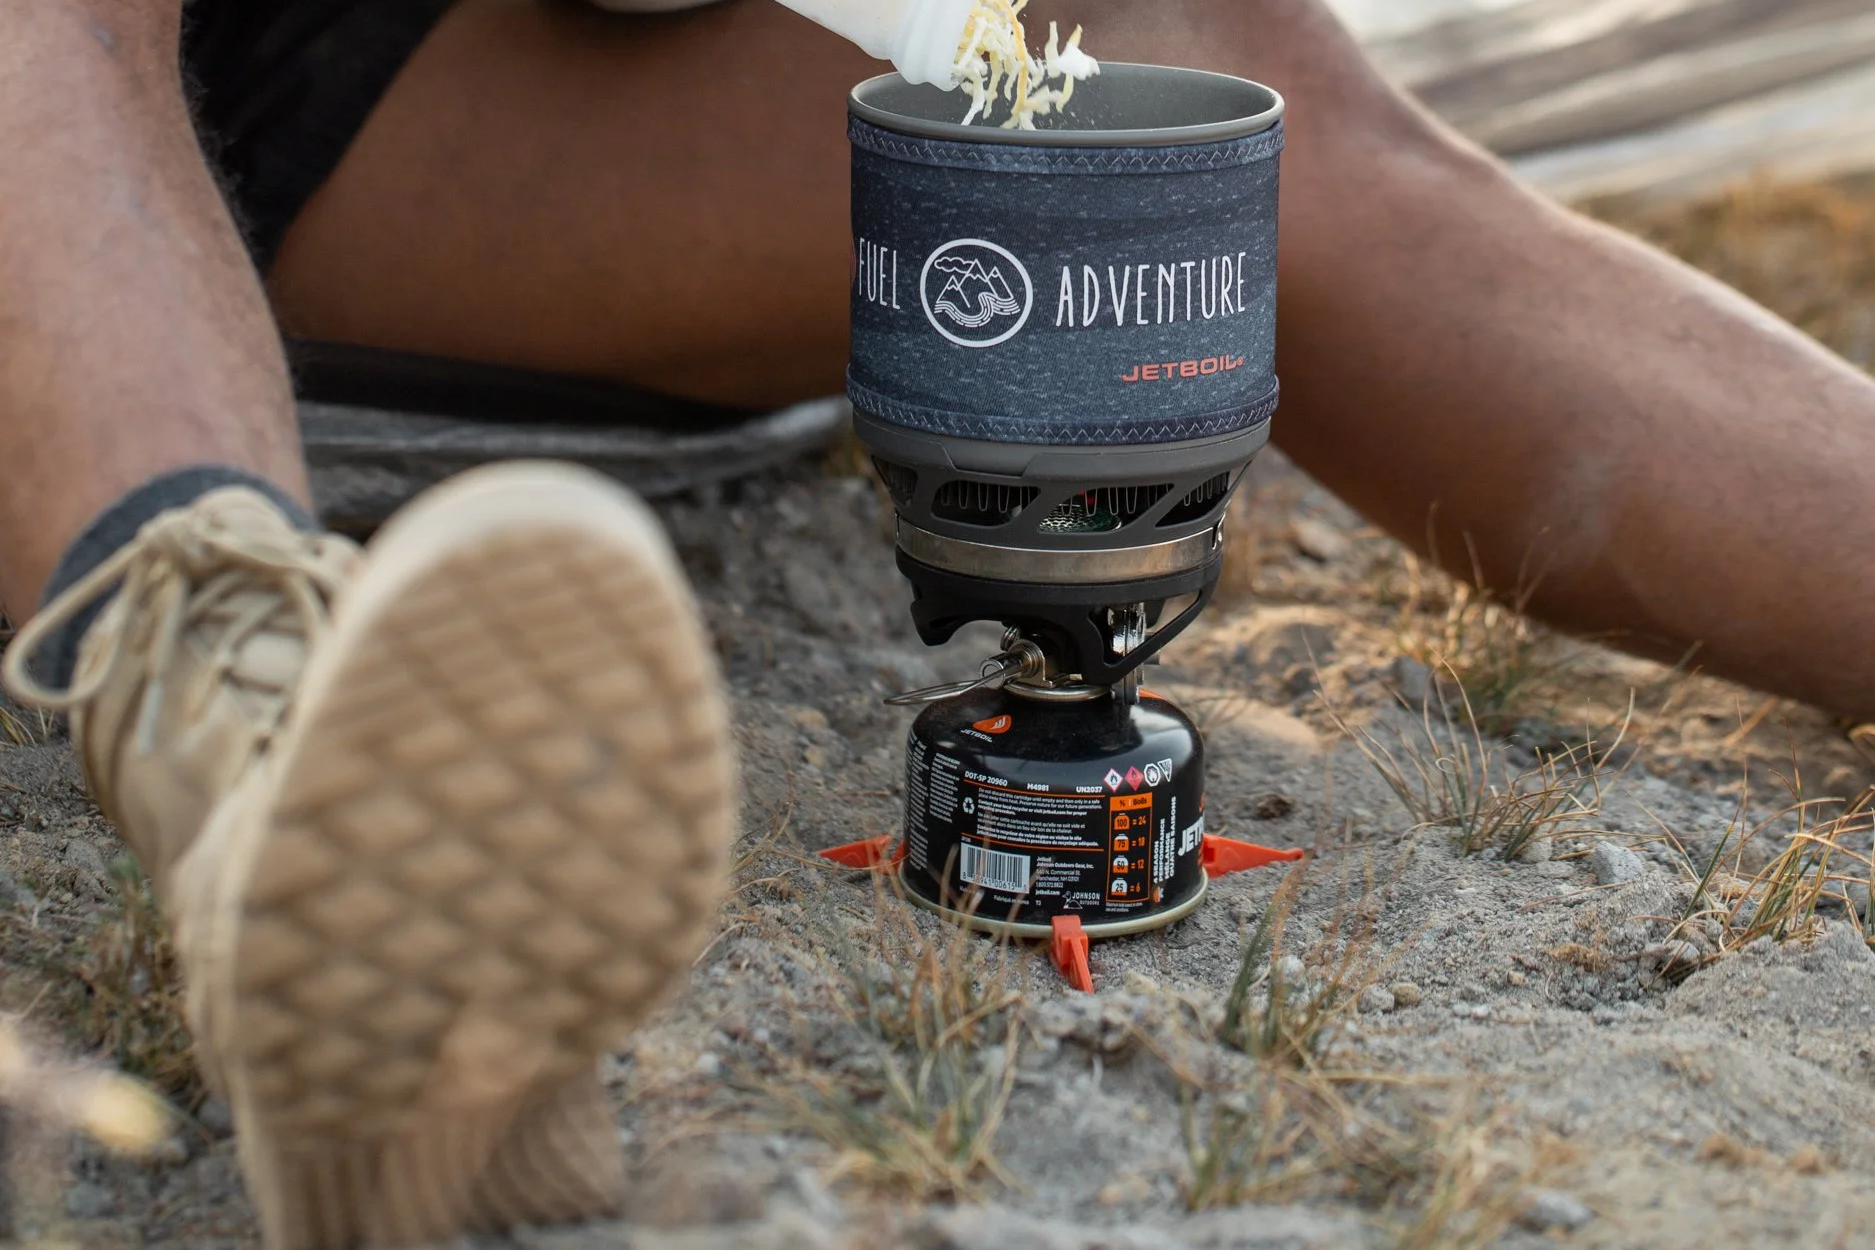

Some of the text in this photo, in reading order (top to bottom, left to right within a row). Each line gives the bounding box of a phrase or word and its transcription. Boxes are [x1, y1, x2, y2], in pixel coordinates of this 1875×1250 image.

[858, 237, 1246, 328] FUEL ADVENTURE
[960, 728, 993, 743] JETBOIL
[964, 771, 1103, 794] DOT-SP 20960 M4981 UN2037
[1117, 819, 1128, 828] 100
[1138, 816, 1147, 826] 24
[1117, 838, 1126, 849] 75
[1117, 860, 1125, 870] 50
[1137, 859, 1144, 869] 12
[963, 871, 967, 879] 8
[1115, 883, 1123, 892] 25
[1072, 892, 1100, 900] JOHNSON
